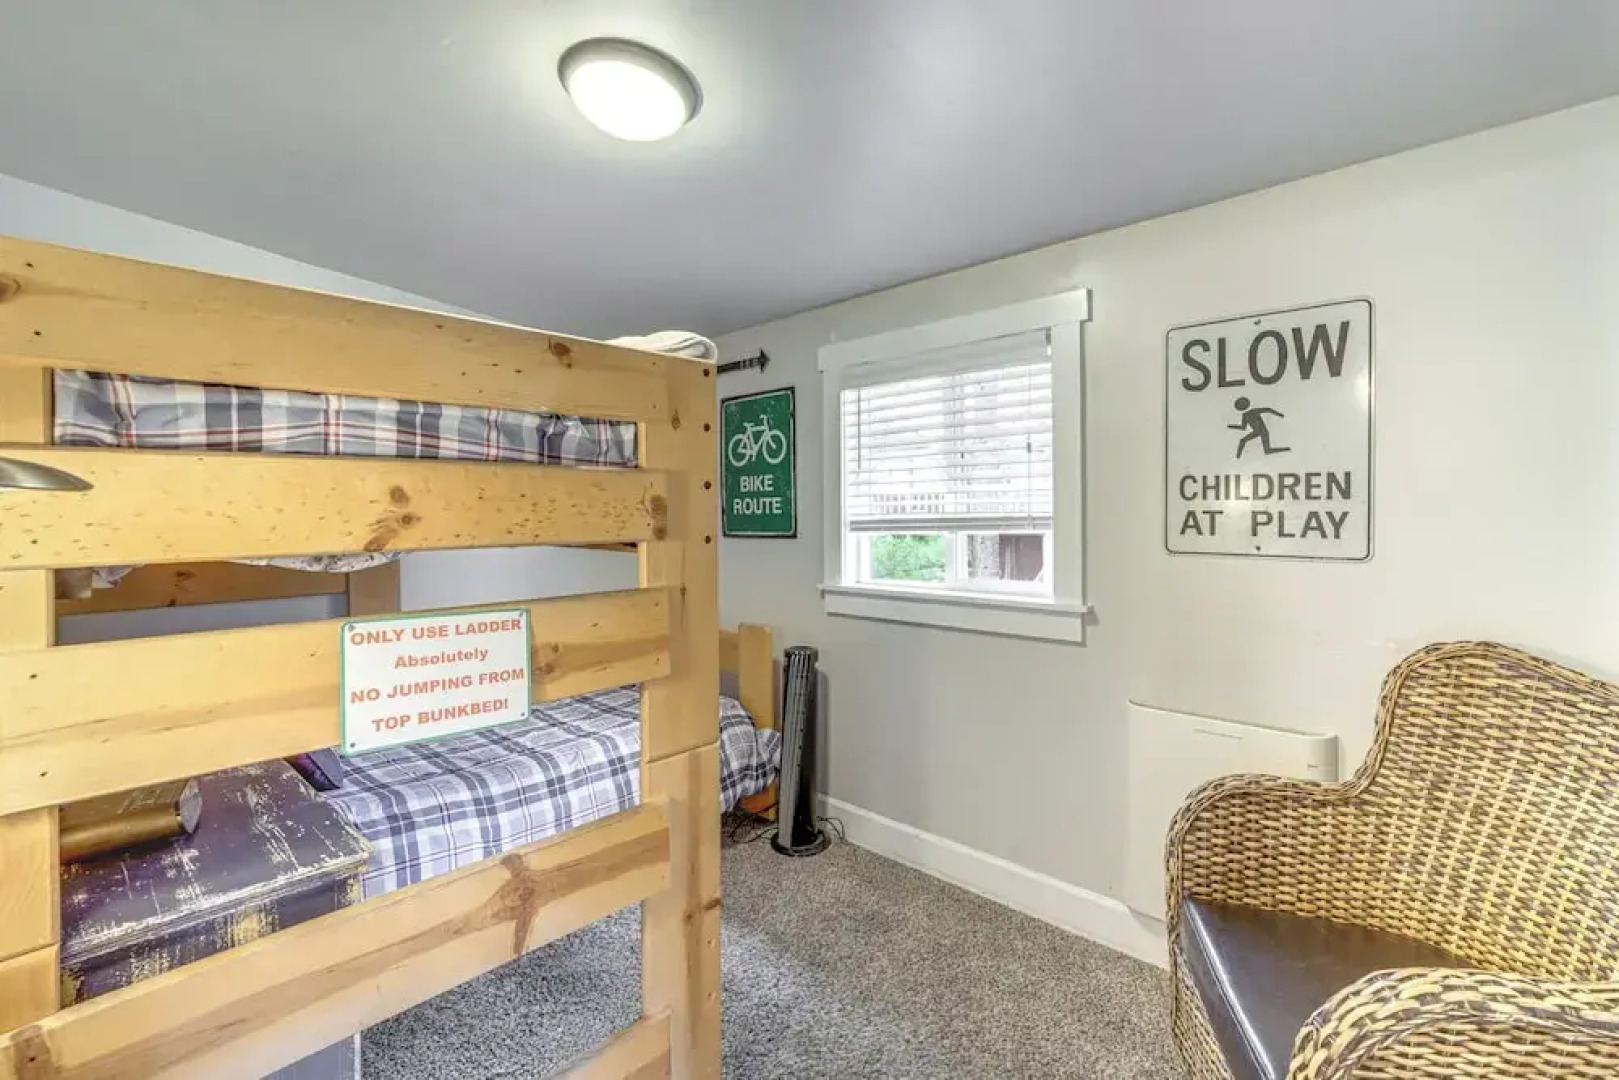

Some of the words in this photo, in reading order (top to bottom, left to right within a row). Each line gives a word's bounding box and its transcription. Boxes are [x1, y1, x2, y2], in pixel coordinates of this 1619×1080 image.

[1181, 320, 1350, 393] SLOW
[739, 474, 774, 493] BIKE
[1179, 470, 1351, 502] CHILDREN
[732, 497, 783, 516] ROUTE
[1179, 509, 1224, 536] AT
[1250, 510, 1350, 540] PLAY
[350, 628, 405, 646] ONLY
[412, 624, 449, 640] USE
[454, 619, 522, 636] LADDER
[394, 648, 488, 669] Absolutely
[351, 687, 380, 704] NO
[387, 675, 473, 699] JUMPING
[478, 668, 525, 686] FROM
[372, 714, 411, 732] TOP
[417, 698, 509, 725] BUNKBED!
